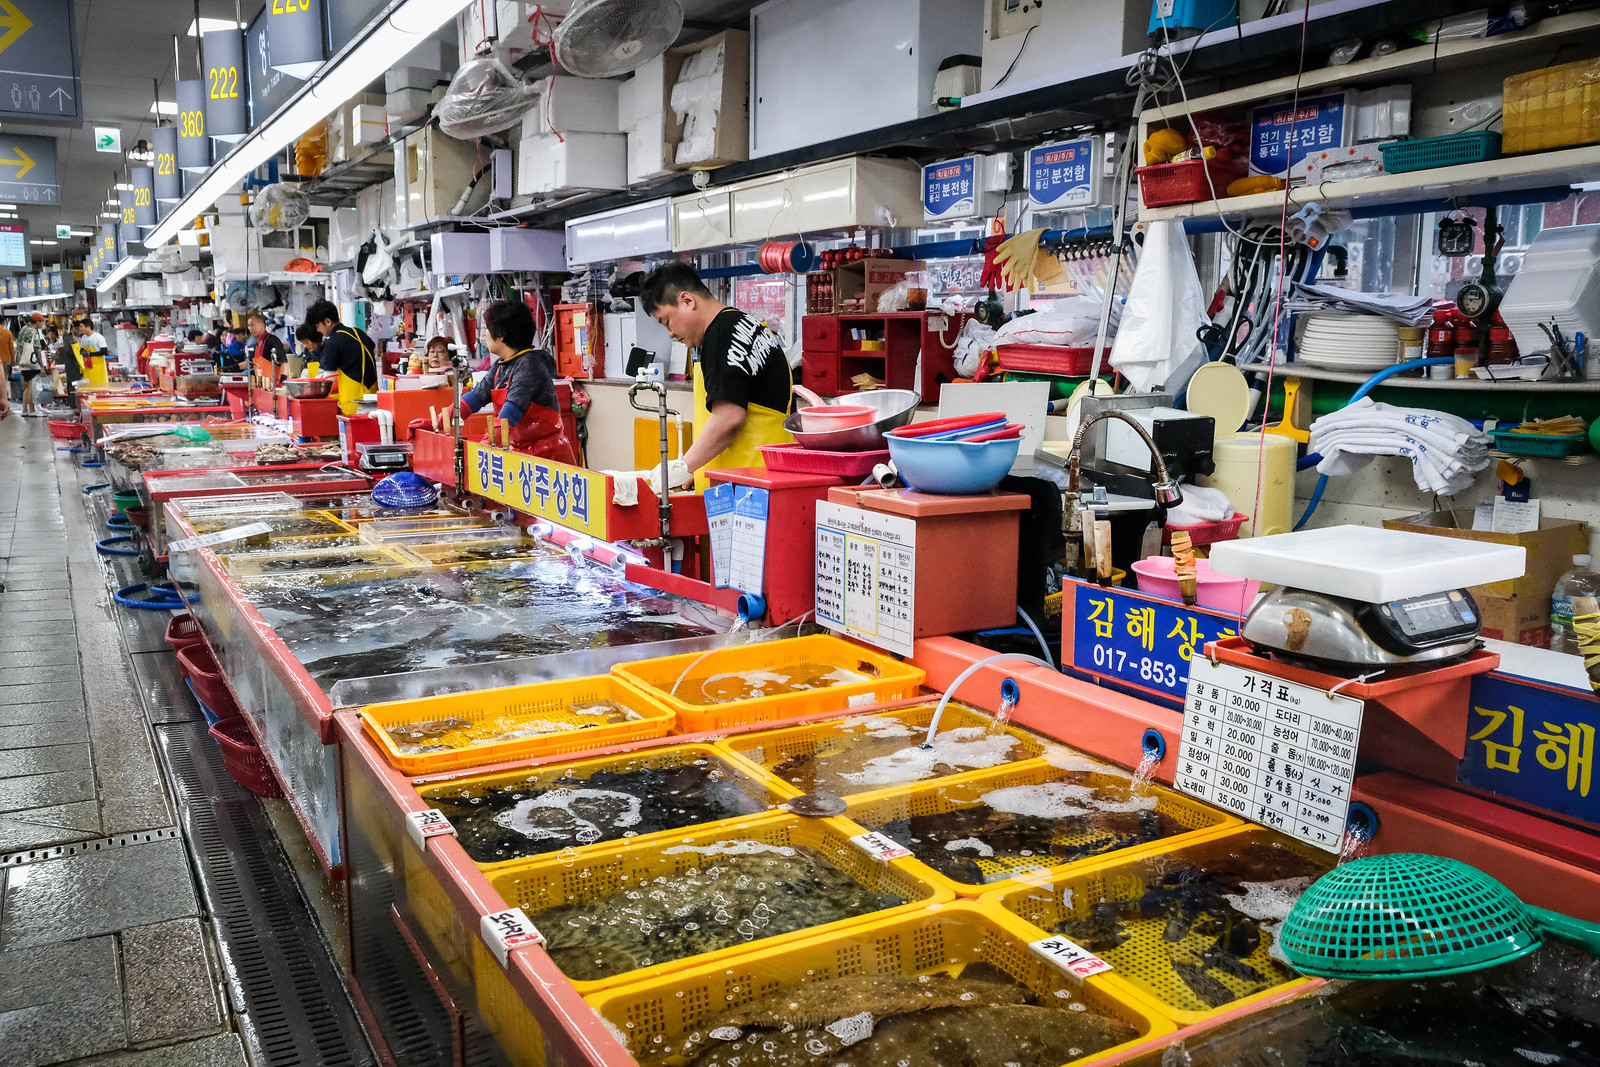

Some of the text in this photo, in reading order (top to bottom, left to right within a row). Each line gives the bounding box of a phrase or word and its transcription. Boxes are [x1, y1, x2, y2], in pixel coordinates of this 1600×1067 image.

[209, 67, 239, 100] 222
[180, 111, 204, 138] 360
[1260, 130, 1280, 143] 전기
[1284, 124, 1334, 150] 분전함
[1259, 145, 1279, 158] 통신
[158, 153, 175, 175] 221
[1035, 168, 1049, 178] 전기
[1051, 165, 1085, 184] 분전함
[929, 183, 940, 192] 전기
[942, 179, 969, 197] 분전함
[1035, 180, 1049, 190] 통신
[135, 187, 151, 206] 220
[929, 194, 940, 203] 통신
[123, 207, 135, 224] 219
[726, 339, 750, 376] YOU
[477, 448, 505, 496] 경북
[519, 460, 590, 526] 상주상회
[1243, 675, 1290, 702] 가격표
[1231, 695, 1260, 712] 30.000
[1275, 708, 1301, 726] 도다리
[1227, 728, 1256, 746] 20.000
[1273, 725, 1299, 743] 능성어
[1224, 744, 1253, 762] 20.000
[1470, 705, 1596, 798] 김해
[1188, 746, 1251, 778] 점성어 30.000
[1183, 778, 1246, 811] 노래미 35.000
[1220, 776, 1248, 795] 30.000
[1041, 940, 1086, 967] 쥐치
